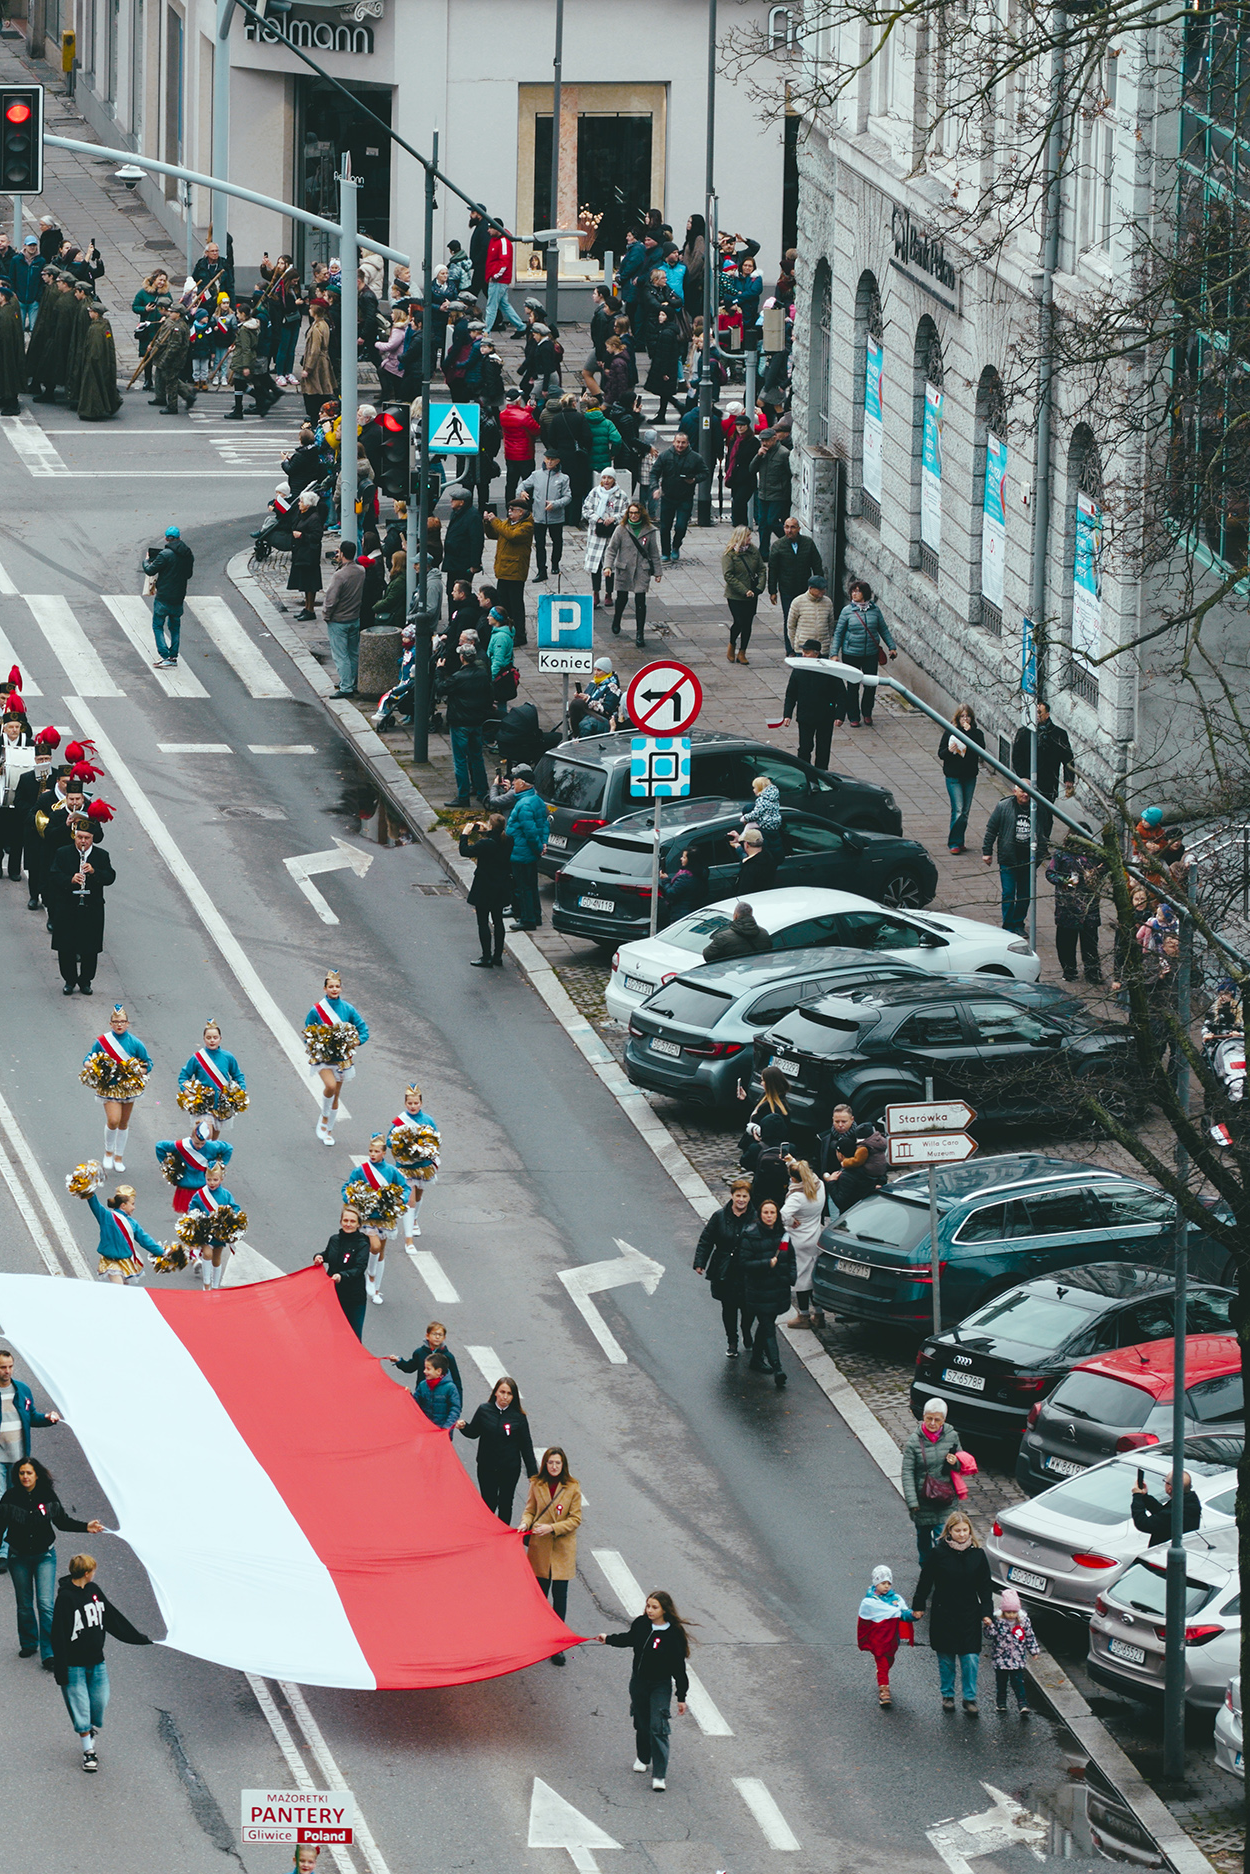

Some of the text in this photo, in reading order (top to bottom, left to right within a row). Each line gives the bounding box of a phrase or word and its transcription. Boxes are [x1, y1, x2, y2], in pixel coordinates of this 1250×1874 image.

[551, 601, 581, 642] P
[540, 655, 591, 669] Koniec
[899, 1113, 948, 1124] Starówka
[947, 1370, 982, 1390] SZ 6578R
[1012, 1568, 1021, 1581] SG
[71, 1601, 105, 1641] ART
[1112, 1640, 1145, 1663] SG 6552X
[266, 1793, 328, 1803] MAŻORETKI
[251, 1806, 345, 1824] PANTERY
[248, 1829, 346, 1842] Gliwice Poland
